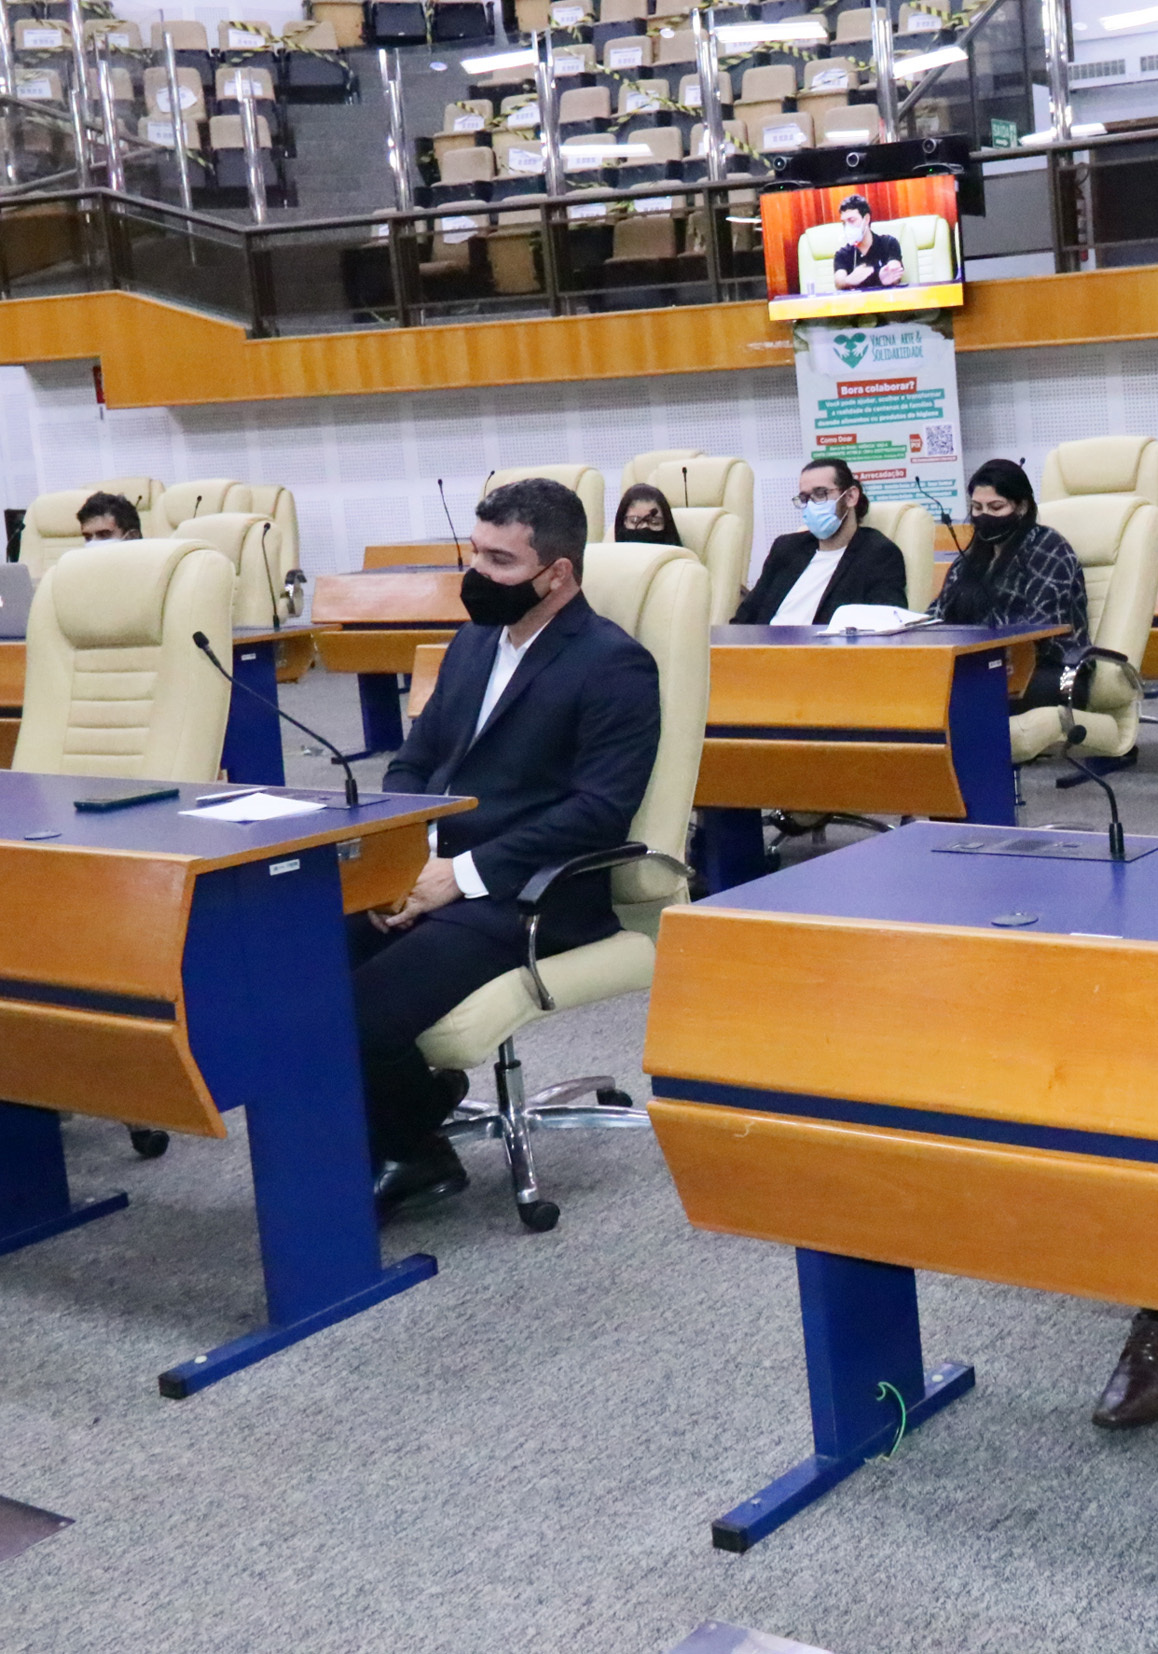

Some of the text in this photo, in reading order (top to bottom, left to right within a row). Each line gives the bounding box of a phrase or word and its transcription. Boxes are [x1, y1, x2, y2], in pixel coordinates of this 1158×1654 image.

[901, 333, 914, 344] ARTE
[915, 331, 922, 343] &
[872, 346, 923, 362] SOLIDARIEDADE
[841, 381, 915, 396] Bora colaborar?
[825, 400, 840, 408] Você
[841, 399, 856, 407] pode
[820, 435, 853, 445] Como Doar
[860, 470, 904, 480] Arrecadação
